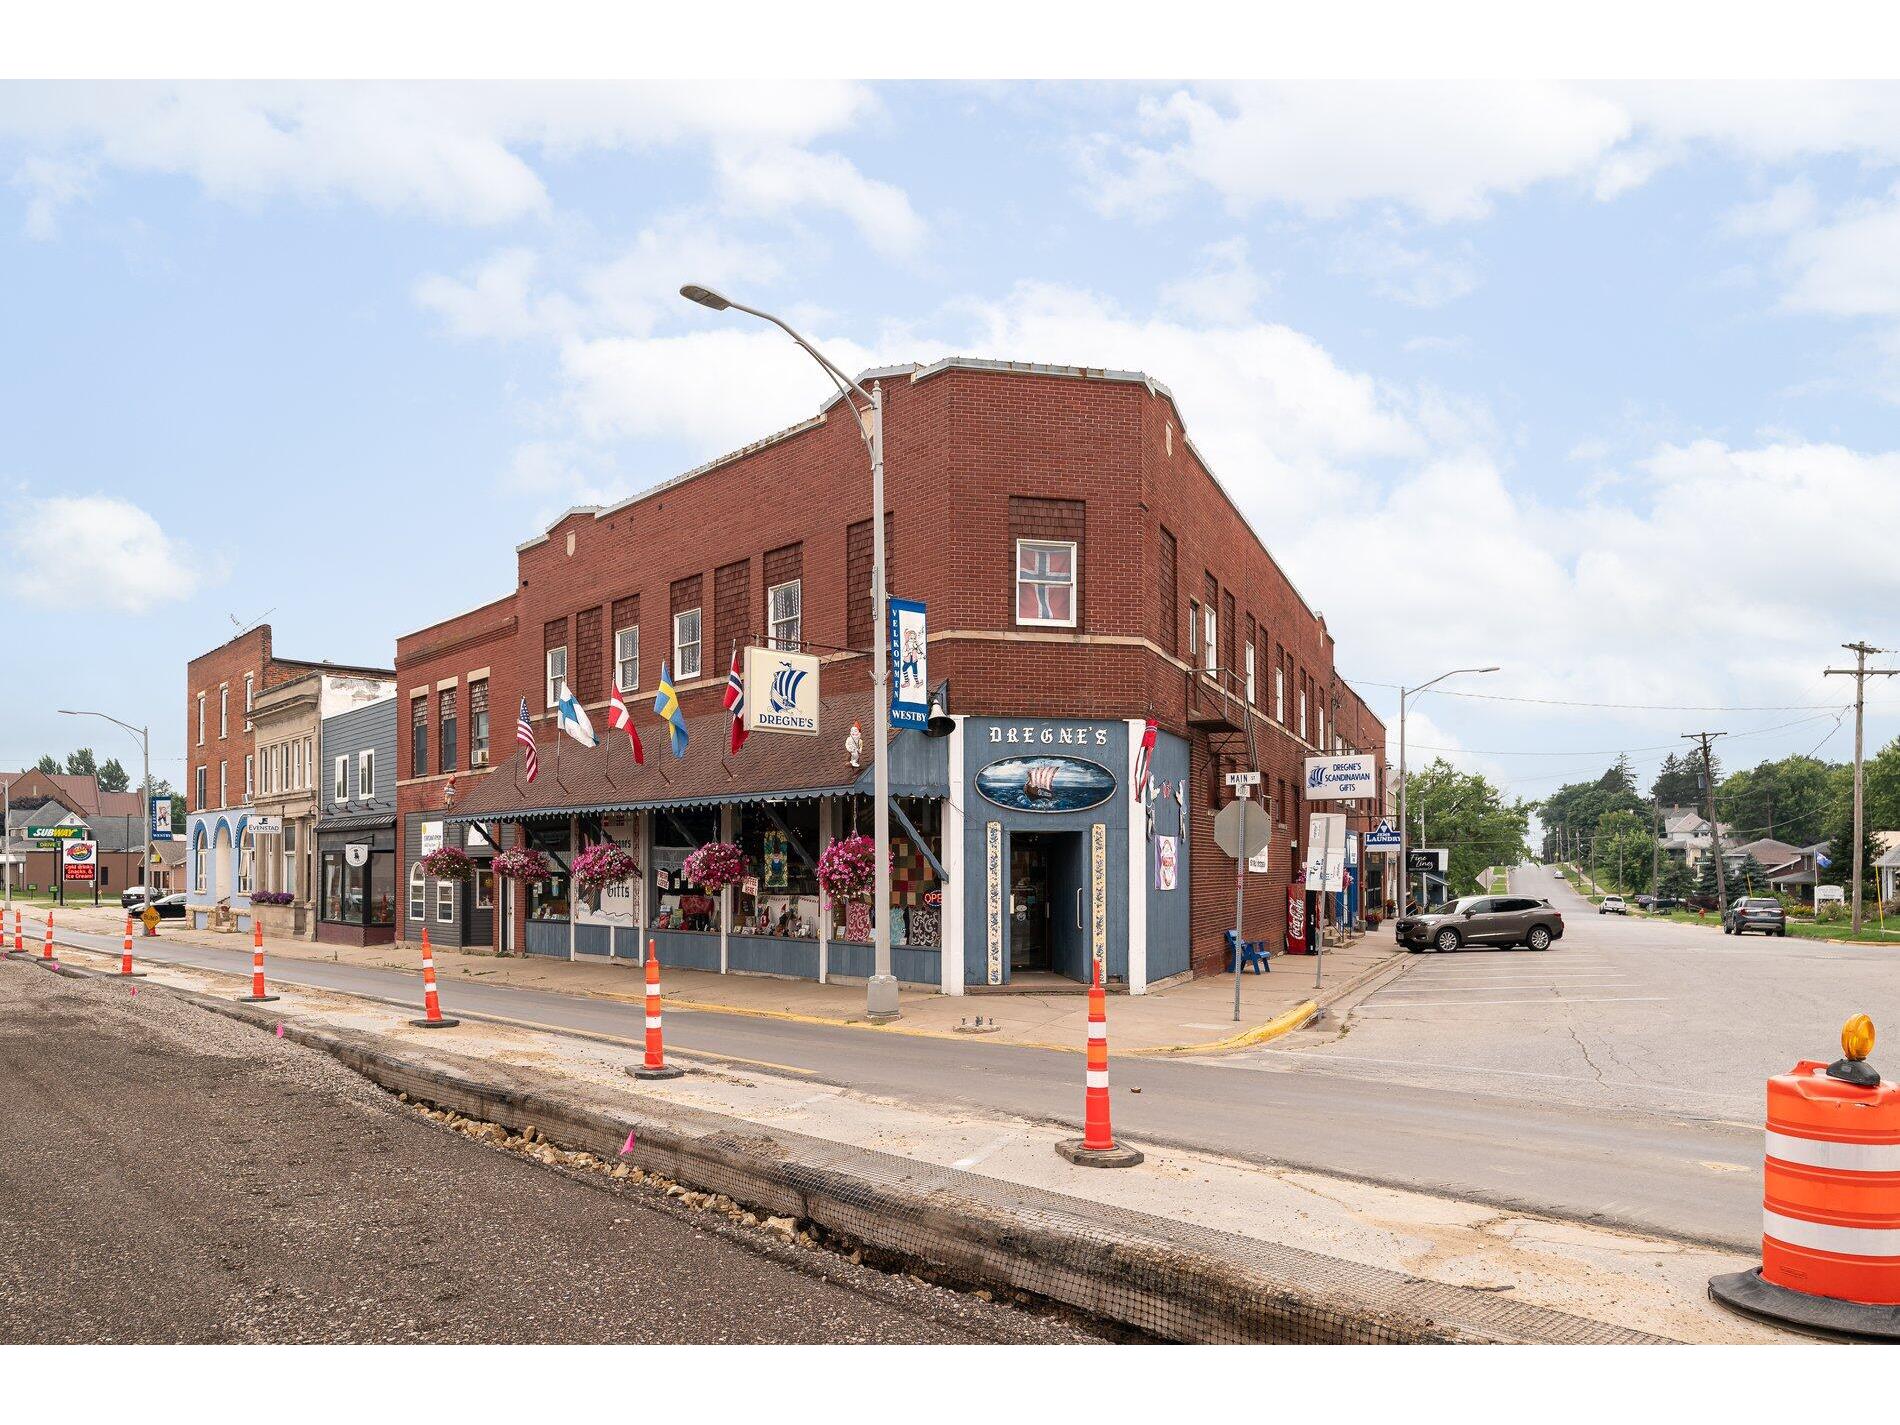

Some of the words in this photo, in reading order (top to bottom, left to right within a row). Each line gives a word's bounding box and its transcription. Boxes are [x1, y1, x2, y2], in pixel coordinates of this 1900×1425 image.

[892, 709, 927, 723] WESTBY
[759, 713, 814, 729] DREGNE'S
[989, 726, 1108, 745] DREGNE'S
[1333, 763, 1361, 771] DREGNE'S
[1230, 774, 1248, 783] MAIN
[1325, 773, 1370, 782] SCANDINAVIAN
[1339, 783, 1356, 792] GIFTS
[33, 828, 78, 837] SUBWAY
[1410, 853, 1427, 862] Fine
[1415, 860, 1433, 870] Lines
[607, 881, 630, 898] Gifts
[924, 893, 942, 903] OPE
